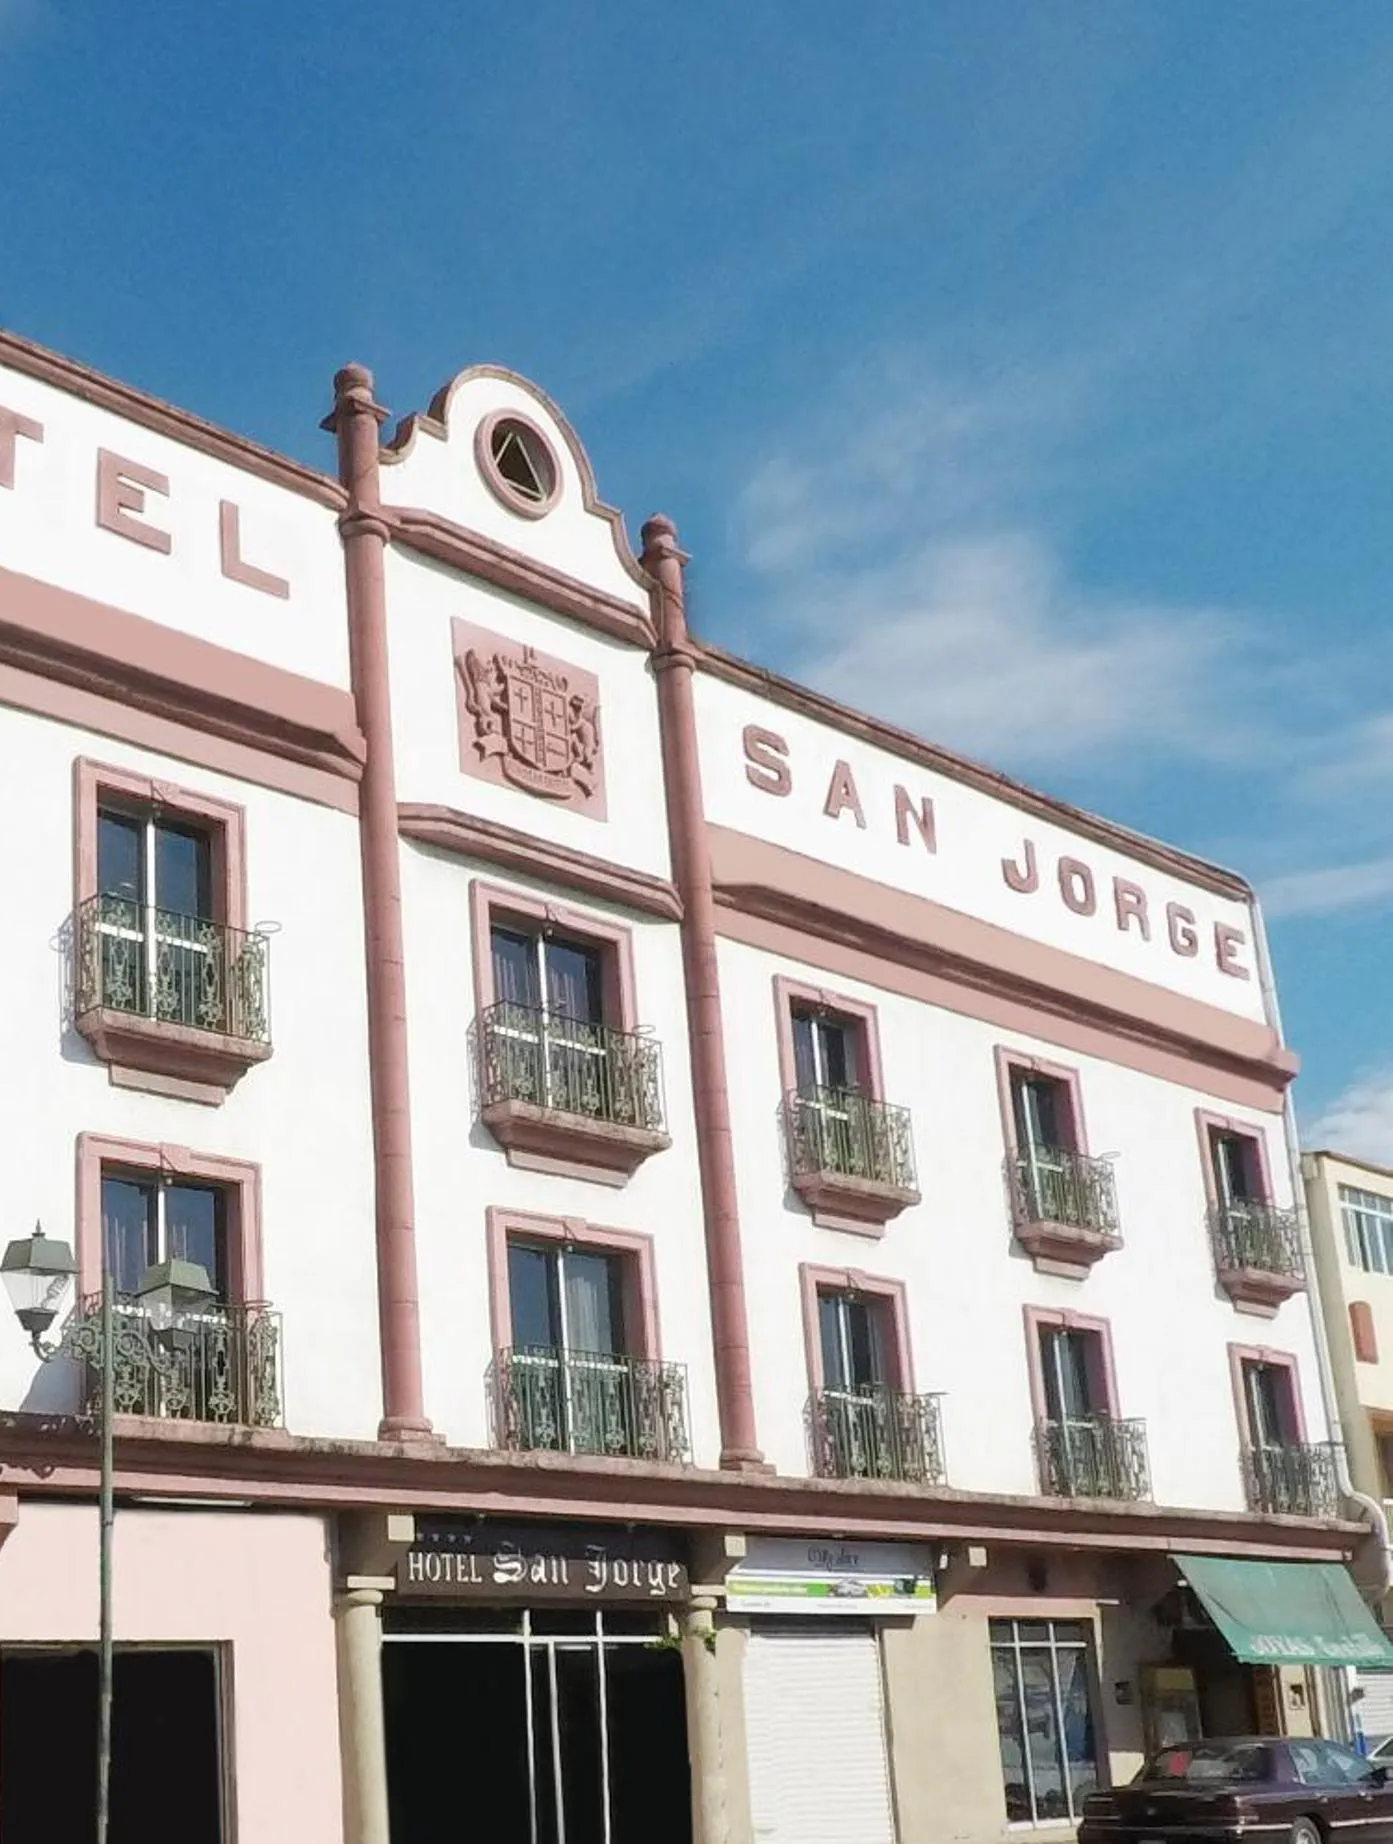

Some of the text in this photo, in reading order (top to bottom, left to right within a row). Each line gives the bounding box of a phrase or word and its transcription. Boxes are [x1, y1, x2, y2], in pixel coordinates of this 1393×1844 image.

[742, 724, 937, 854] SAN
[1002, 839, 1251, 980] JORGE
[408, 1541, 682, 1596] HOTEL San Jorge
